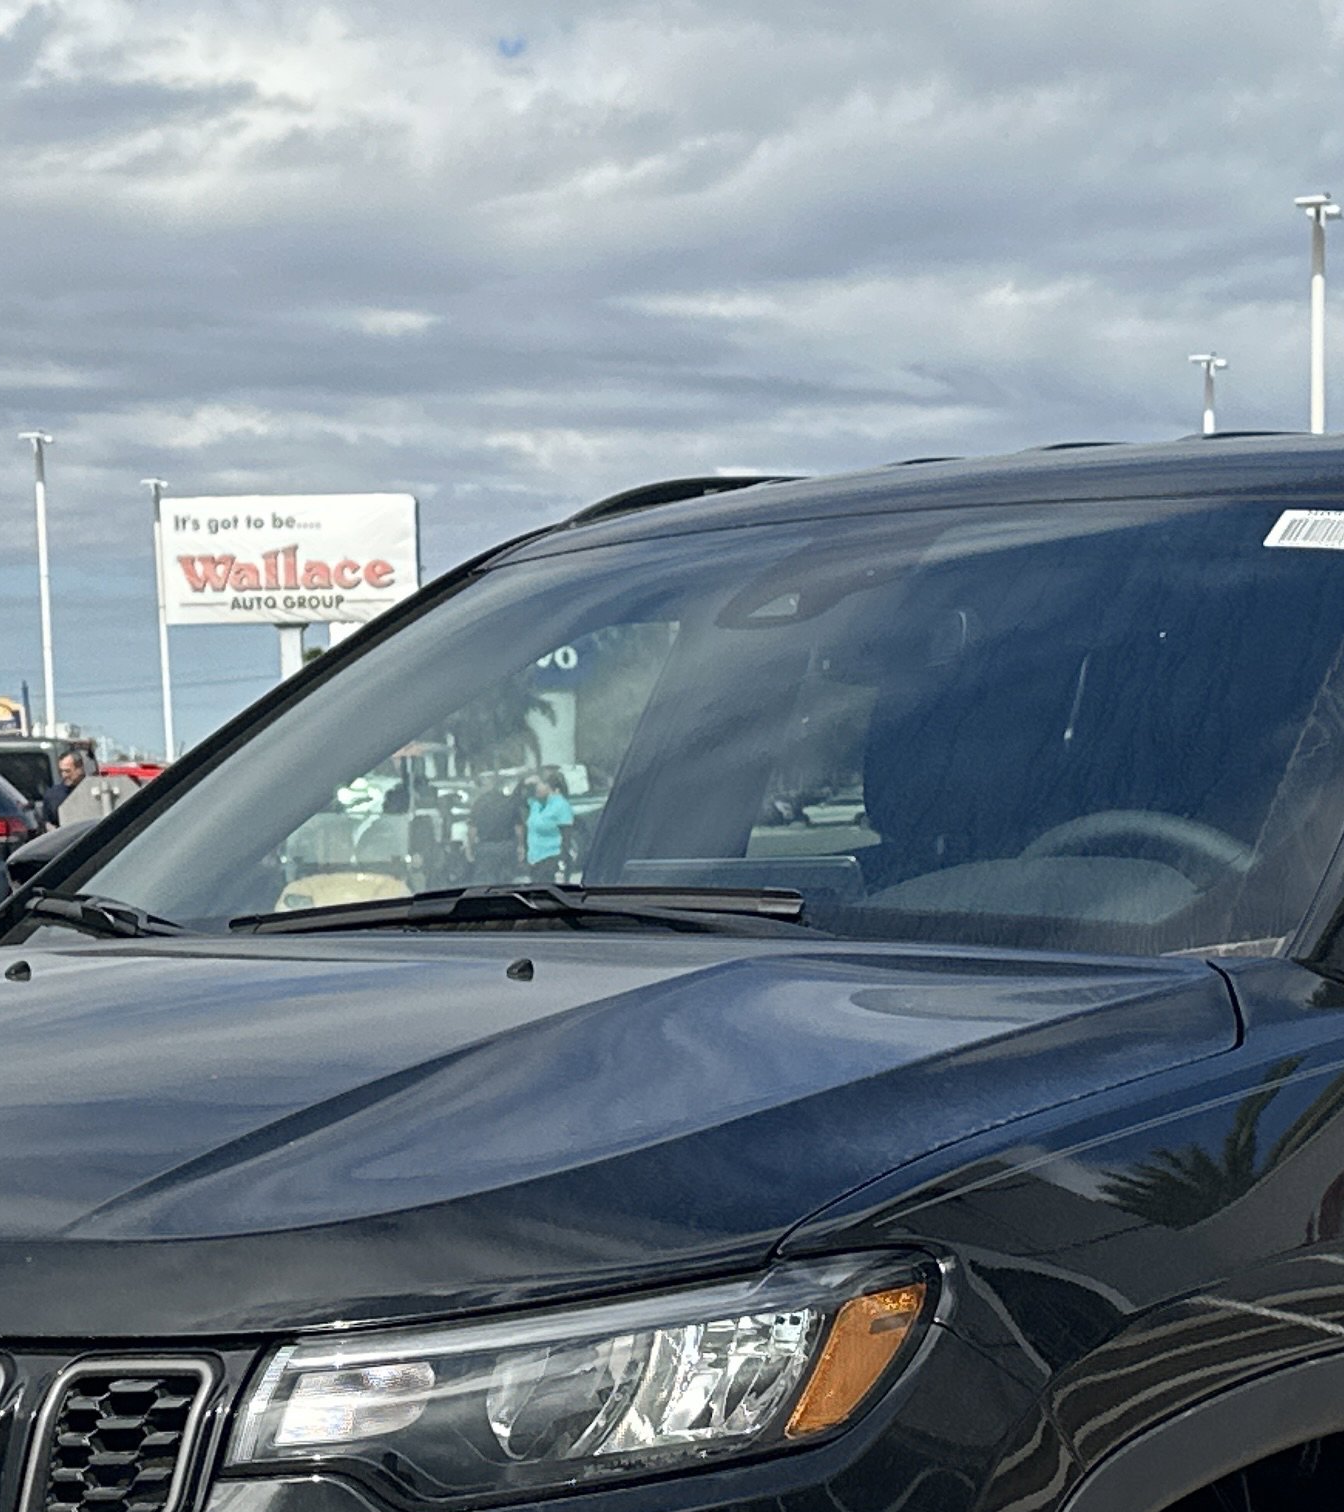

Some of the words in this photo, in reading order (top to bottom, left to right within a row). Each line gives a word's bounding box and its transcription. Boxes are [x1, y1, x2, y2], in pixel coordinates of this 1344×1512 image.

[173, 513, 201, 532] It's
[207, 514, 239, 535] got
[245, 514, 265, 530] to
[176, 543, 396, 593] Wallace
[230, 595, 278, 611] AUTO
[283, 594, 346, 610] GROUP
